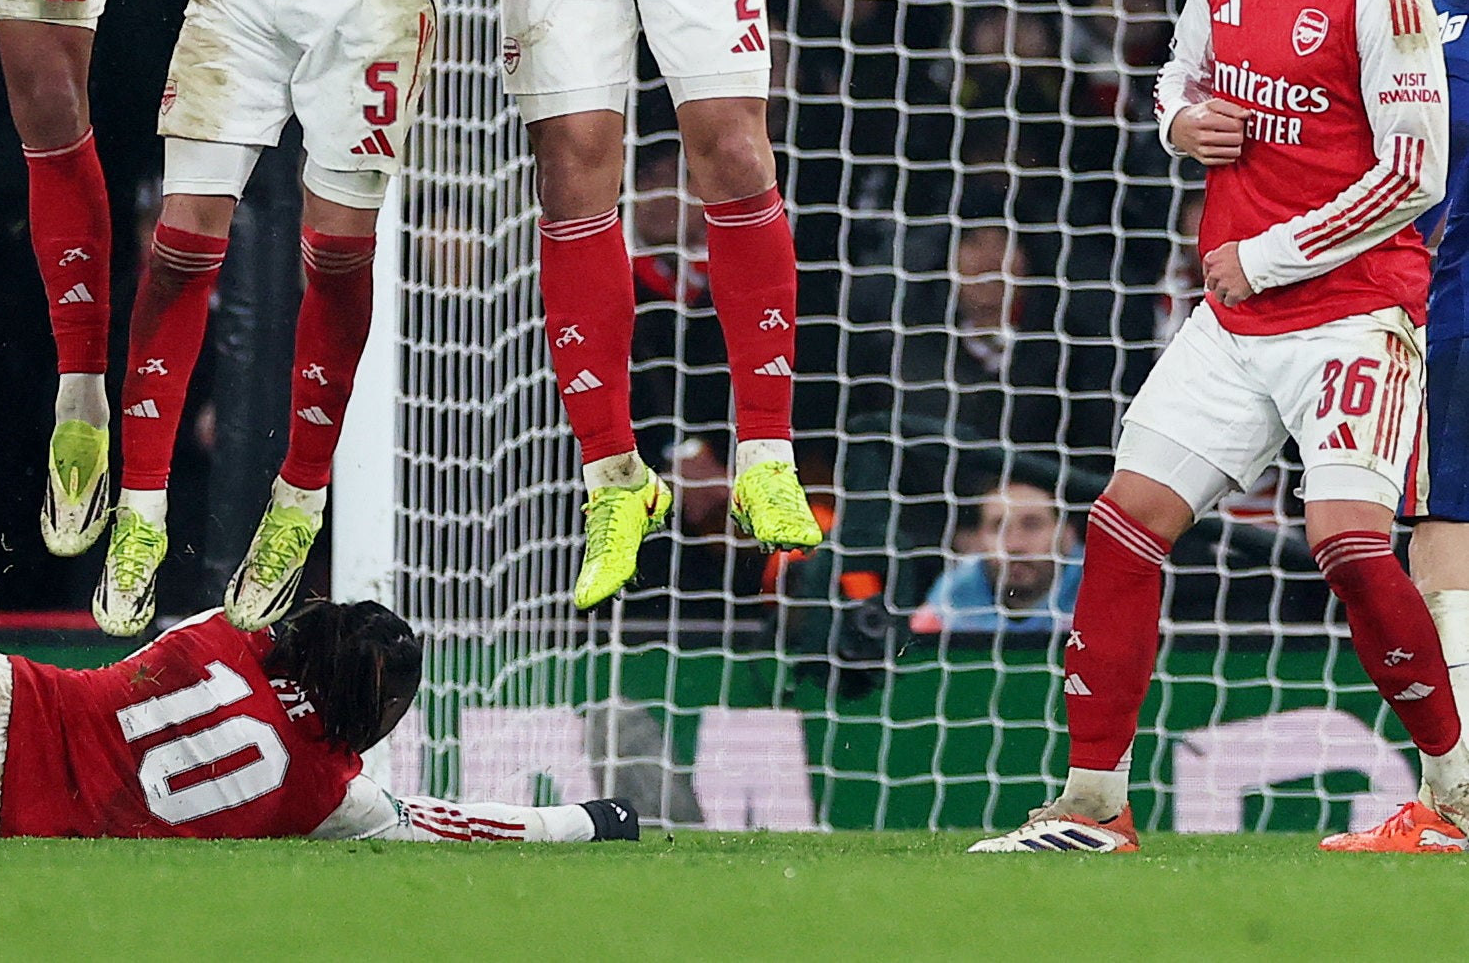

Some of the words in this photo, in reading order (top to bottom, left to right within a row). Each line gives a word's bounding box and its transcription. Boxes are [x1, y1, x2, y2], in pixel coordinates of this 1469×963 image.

[363, 61, 398, 126] 5
[1212, 59, 1330, 114] mirates
[1378, 89, 1442, 105] RWANDA
[1392, 72, 1427, 87] VISIT
[1245, 108, 1302, 145] ETTER
[1315, 356, 1381, 421] 36
[115, 659, 291, 826] 10
